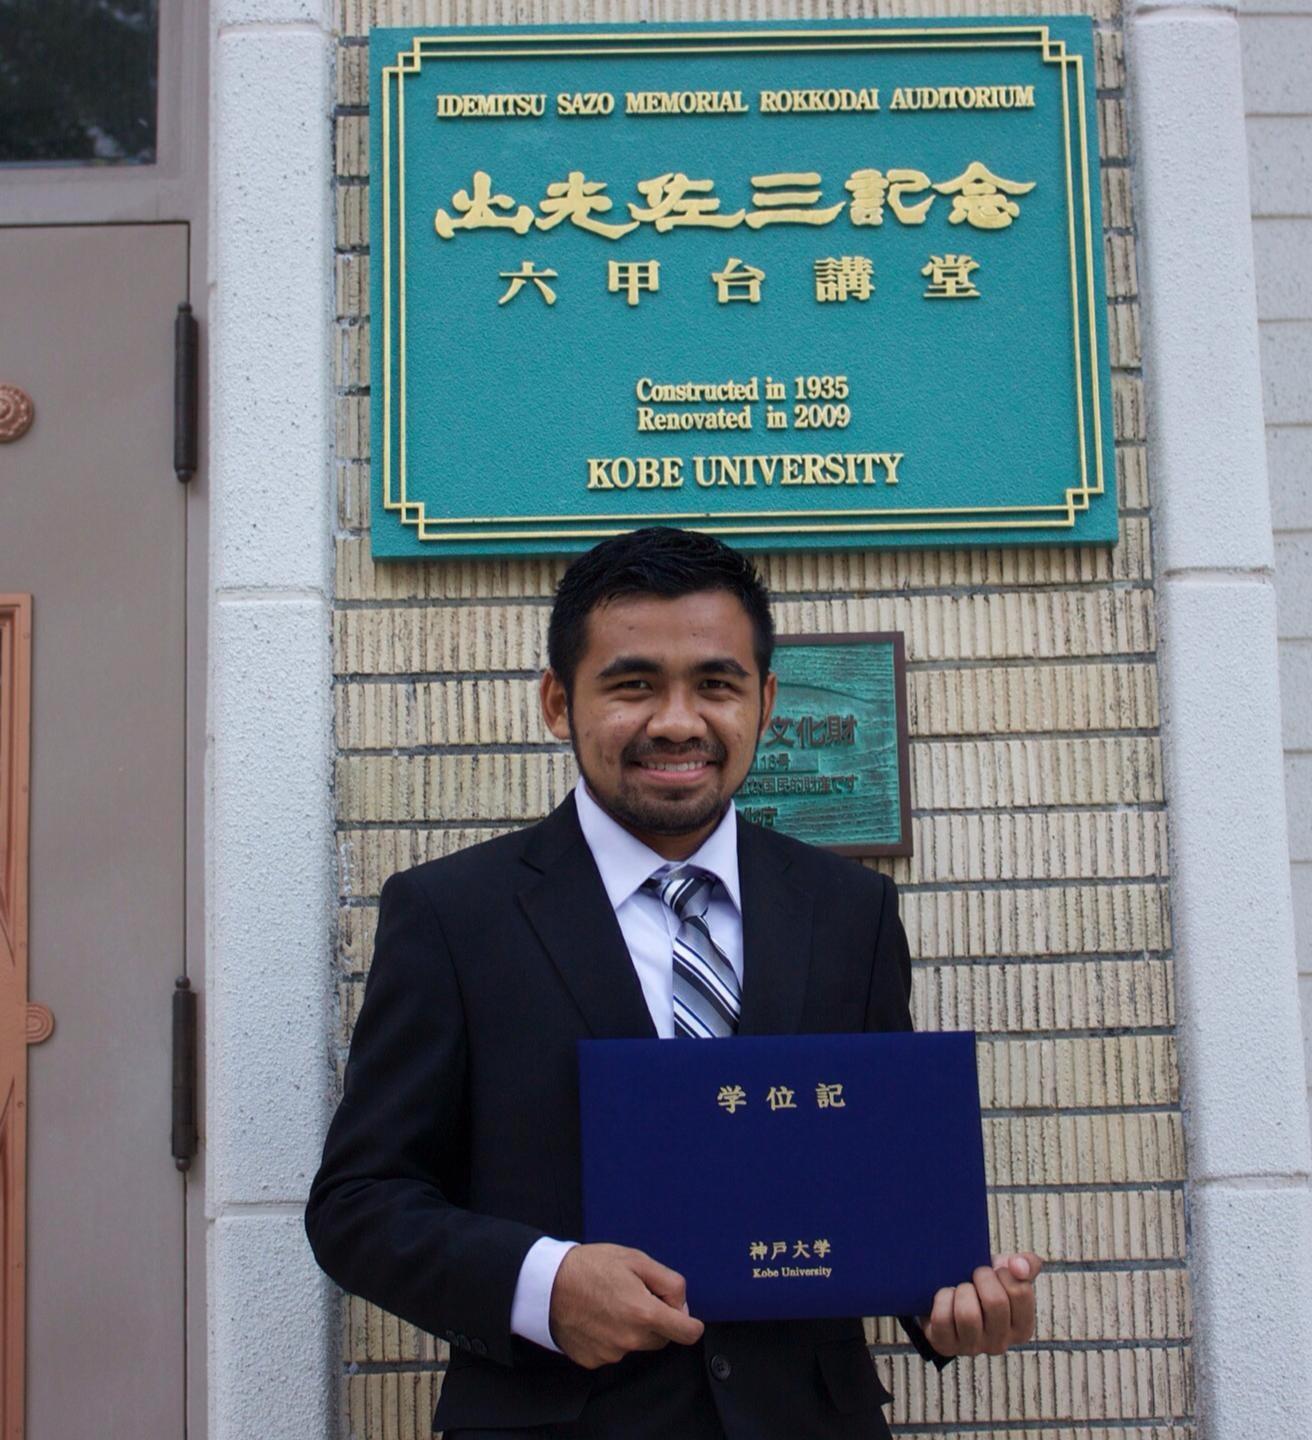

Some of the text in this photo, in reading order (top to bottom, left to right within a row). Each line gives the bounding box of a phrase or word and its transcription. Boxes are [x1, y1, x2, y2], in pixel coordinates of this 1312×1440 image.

[436, 86, 1036, 118] IDEMITSU SAZO MEMORIAL ROKKODAI AUDITORIUM
[434, 160, 1037, 240] 出光佐三記念
[498, 253, 982, 306] 六甲台講堂
[636, 375, 850, 403] Constructed in 1935
[637, 403, 852, 431] Renovated in 2009
[587, 452, 905, 489] KOBE UNIVERSITY
[765, 714, 858, 750] 文化財
[716, 1082, 847, 1113] 学位記
[749, 1239, 832, 1260] 神戸大学
[752, 1265, 832, 1278] Kobe University
